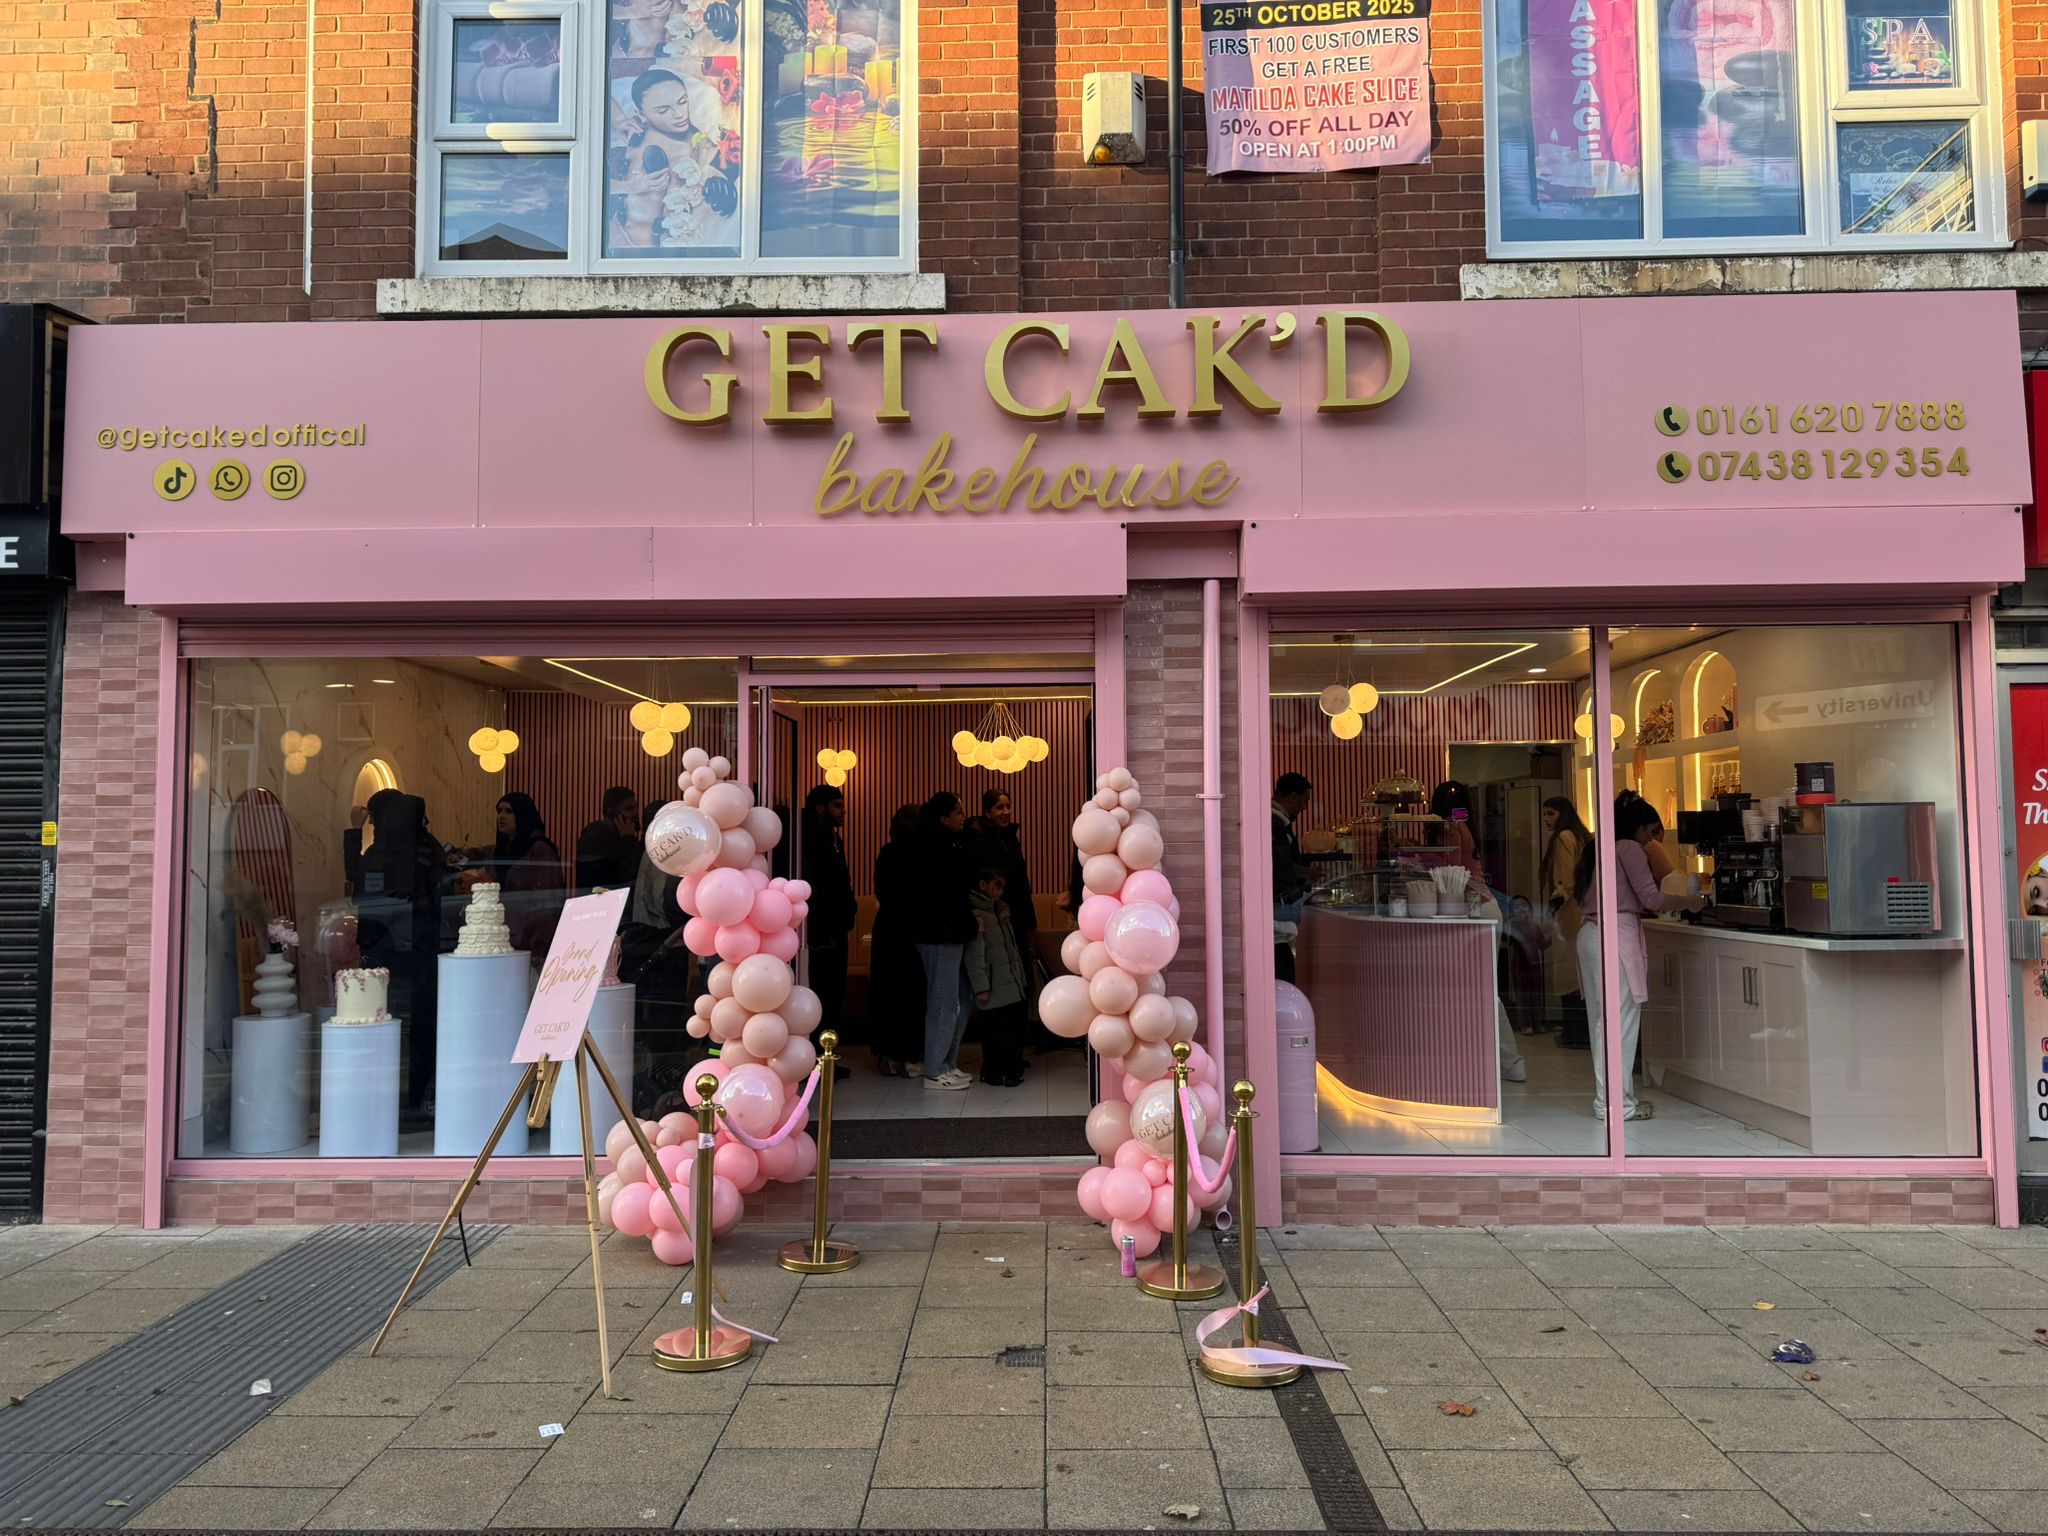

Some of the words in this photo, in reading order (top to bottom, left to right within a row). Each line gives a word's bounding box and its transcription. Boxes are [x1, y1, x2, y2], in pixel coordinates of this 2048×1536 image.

[1257, 1, 1361, 24] OCTOBER
[1367, 0, 1415, 16] 2025
[1208, 37, 1260, 55] FIRST
[1266, 35, 1296, 53] 100
[1301, 26, 1419, 50] CUSTOMERS
[1861, 17, 1936, 45] SPA
[1262, 61, 1299, 79] GET
[1303, 60, 1317, 77] A
[1321, 56, 1371, 75] FREE
[1211, 85, 1298, 112] MATILDA
[1303, 81, 1355, 108] CAKE
[1362, 78, 1420, 103] SLICE
[1218, 119, 1261, 137] 50%
[1268, 118, 1311, 137] OFF
[1318, 115, 1361, 134] ALL
[1369, 111, 1413, 129] DAY
[1239, 141, 1291, 157] OPEN
[1296, 141, 1321, 157] AT
[1327, 135, 1396, 154] 1:00PM
[644, 322, 938, 426] GET
[985, 312, 1411, 421] CAK'D
[1696, 404, 1778, 435] 0161
[1791, 402, 1864, 433] 620
[1872, 400, 1966, 432] 7888
[815, 431, 1240, 517] bakehouse
[1698, 449, 1813, 481] 07438
[0, 536, 20, 568] E
[2032, 769, 2048, 791] S
[538, 956, 599, 1003] Opening
[1138, 1121, 1160, 1139] GET
